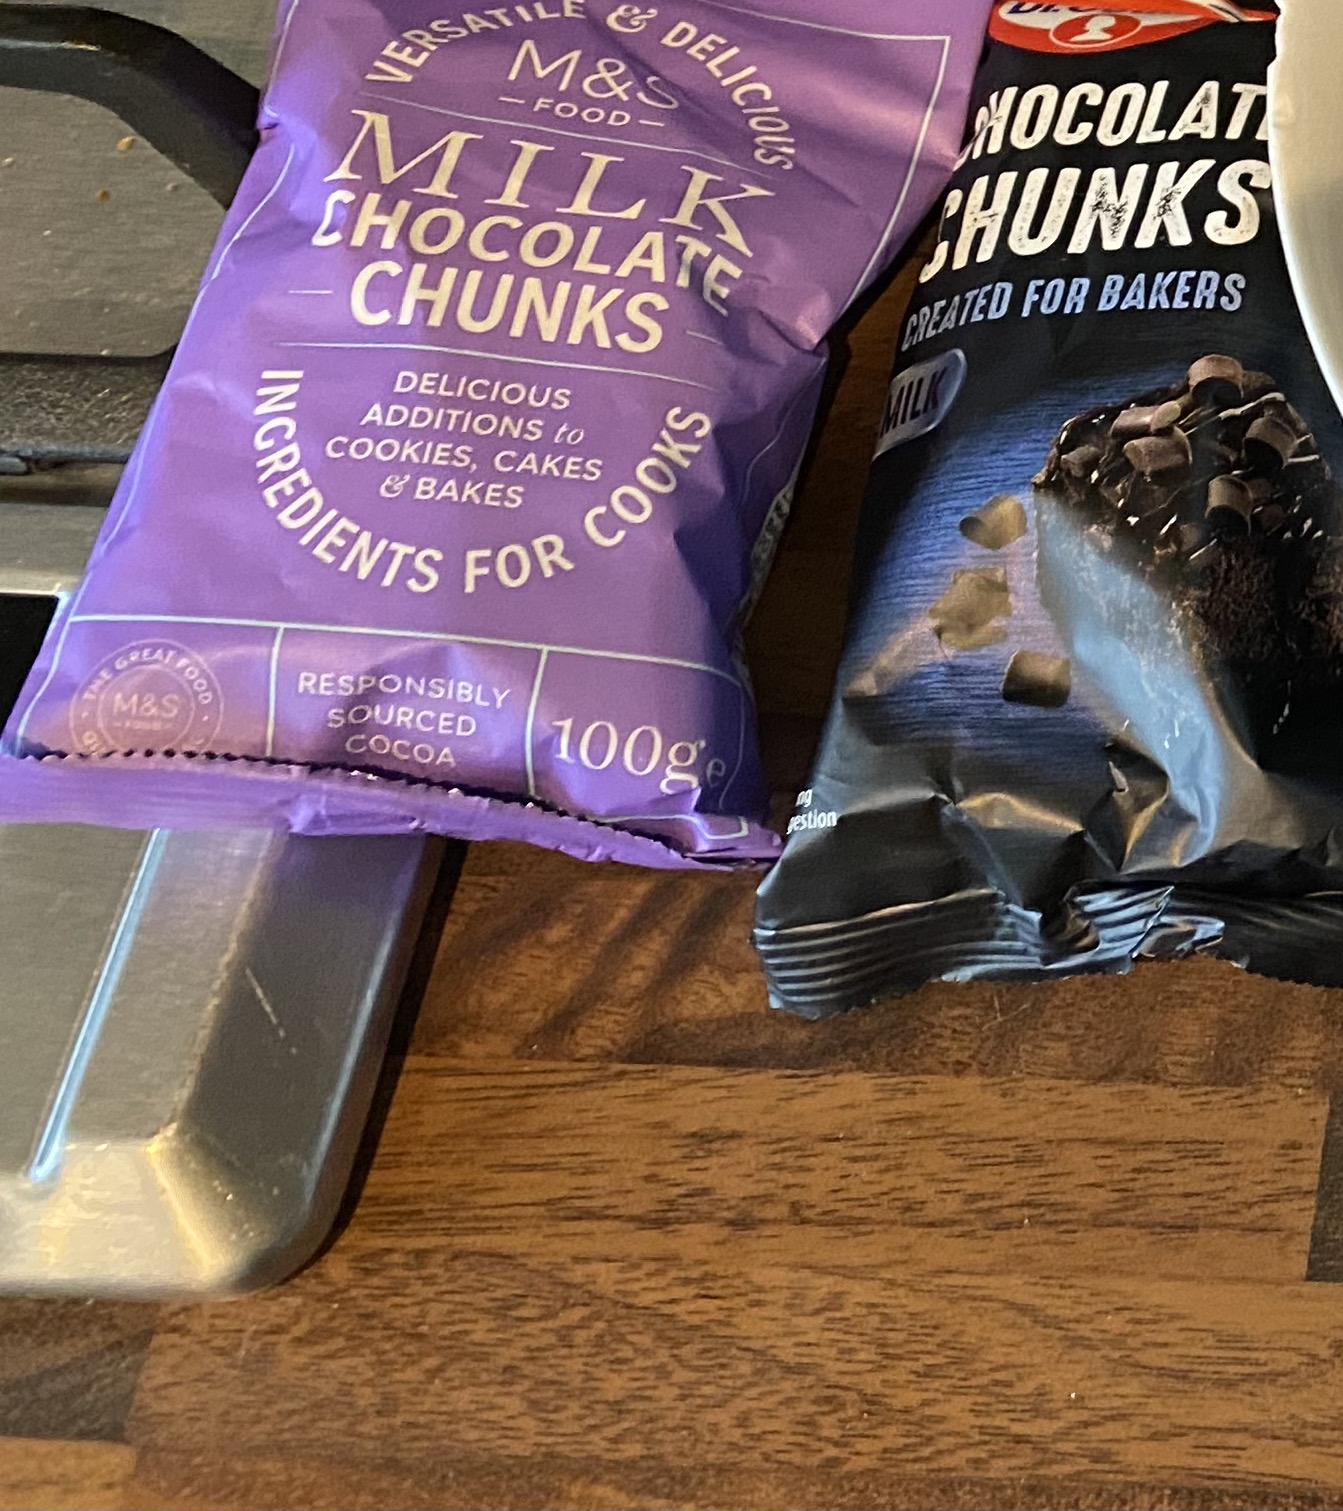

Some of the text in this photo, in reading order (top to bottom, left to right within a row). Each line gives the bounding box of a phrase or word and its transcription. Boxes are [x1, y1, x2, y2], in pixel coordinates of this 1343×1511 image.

[507, 39, 680, 110] M&S
[605, 3, 659, 34] &
[660, 20, 796, 171] DELICIOUS
[532, 97, 632, 127] FOOD
[952, 80, 1269, 173] CHOCOLAT
[322, 108, 777, 259] MILK
[311, 188, 746, 318] CHOCOLATE
[919, 158, 1273, 284] CHUNKS
[350, 259, 670, 354] CHUNKS
[900, 269, 1248, 353] CREATED FOR BAKERS
[359, 402, 586, 446] ADDITIONS to
[392, 370, 572, 411] DELICIOUS
[882, 365, 950, 434] MILK
[252, 369, 445, 595] INGREDIENTS
[463, 533, 577, 595] FOR
[583, 405, 714, 549] COOKS
[324, 436, 604, 482] COOKIES, CAKES
[379, 473, 525, 509] & BAKES
[112, 692, 181, 719] M&S
[297, 671, 513, 710] RESPONSIBLY
[327, 704, 477, 737] SOURCED
[344, 733, 458, 768] COCOA
